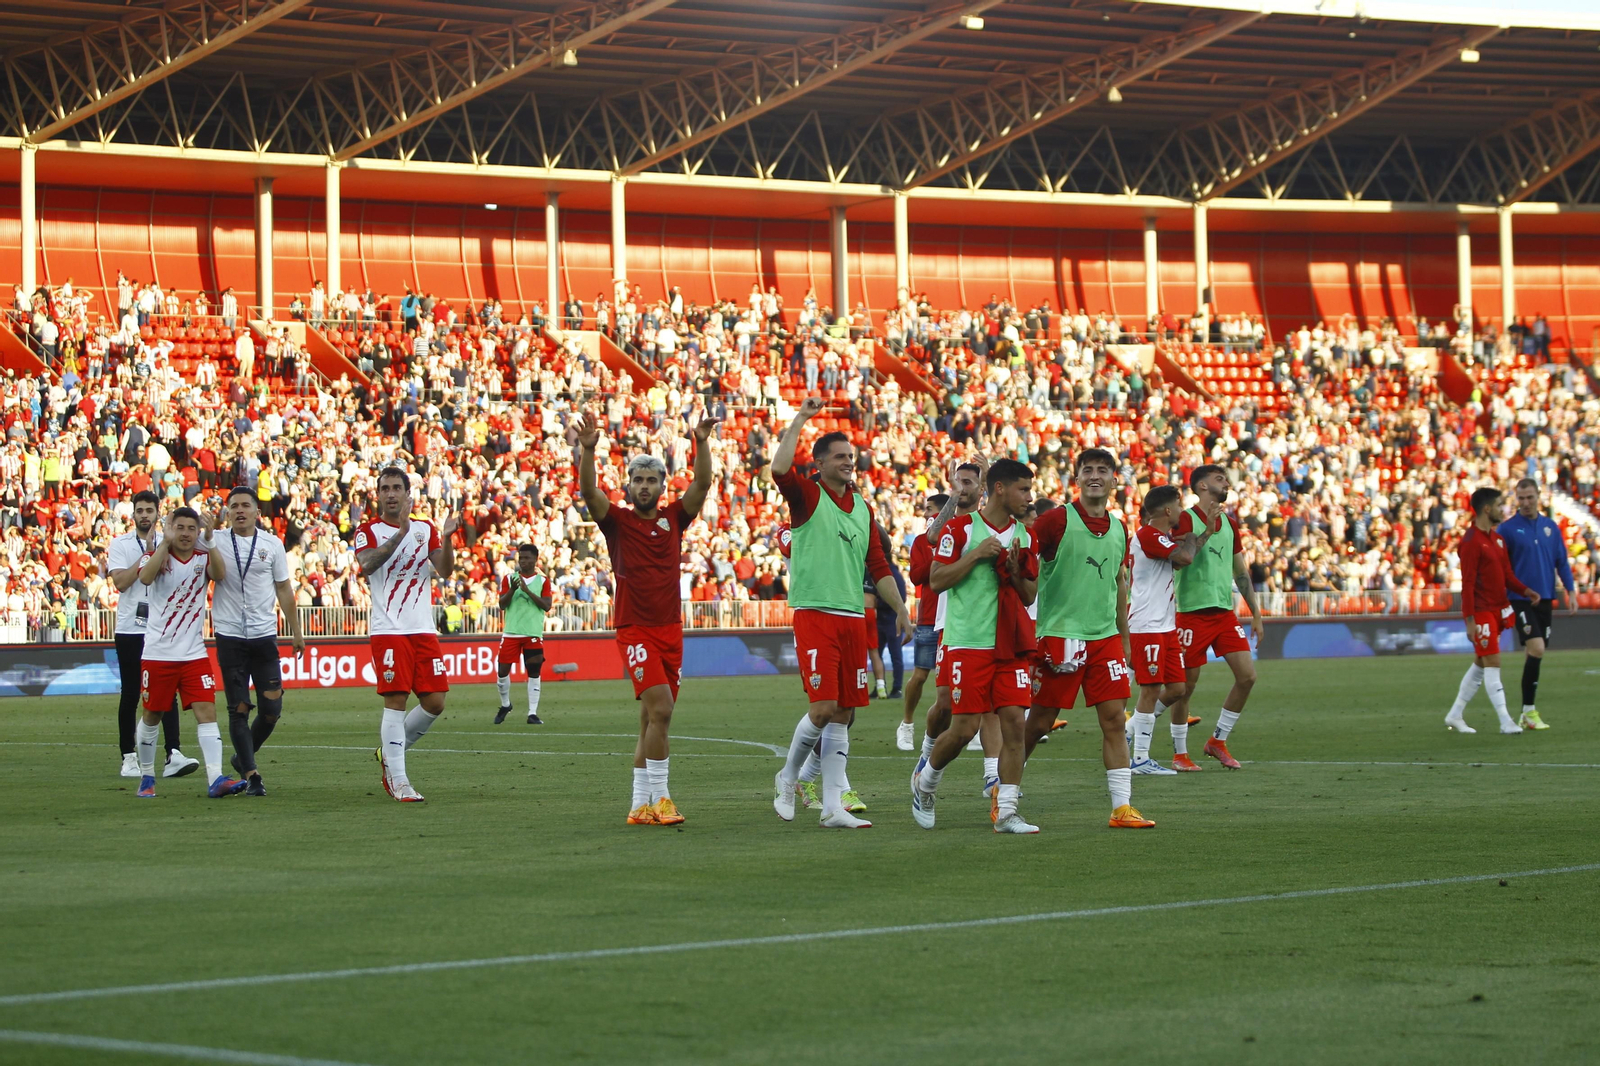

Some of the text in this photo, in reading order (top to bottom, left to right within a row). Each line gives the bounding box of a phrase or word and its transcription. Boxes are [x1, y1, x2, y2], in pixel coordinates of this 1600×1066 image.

[1519, 611, 1527, 624] 1
[1177, 628, 1193, 647] 20
[1476, 623, 1490, 638] 24
[383, 648, 394, 668] 4
[627, 643, 647, 667] 26
[807, 648, 818, 671] 7
[1144, 644, 1160, 662] 17
[279, 647, 356, 686] aLiga
[952, 662, 962, 685] 5
[142, 670, 149, 688] 8
